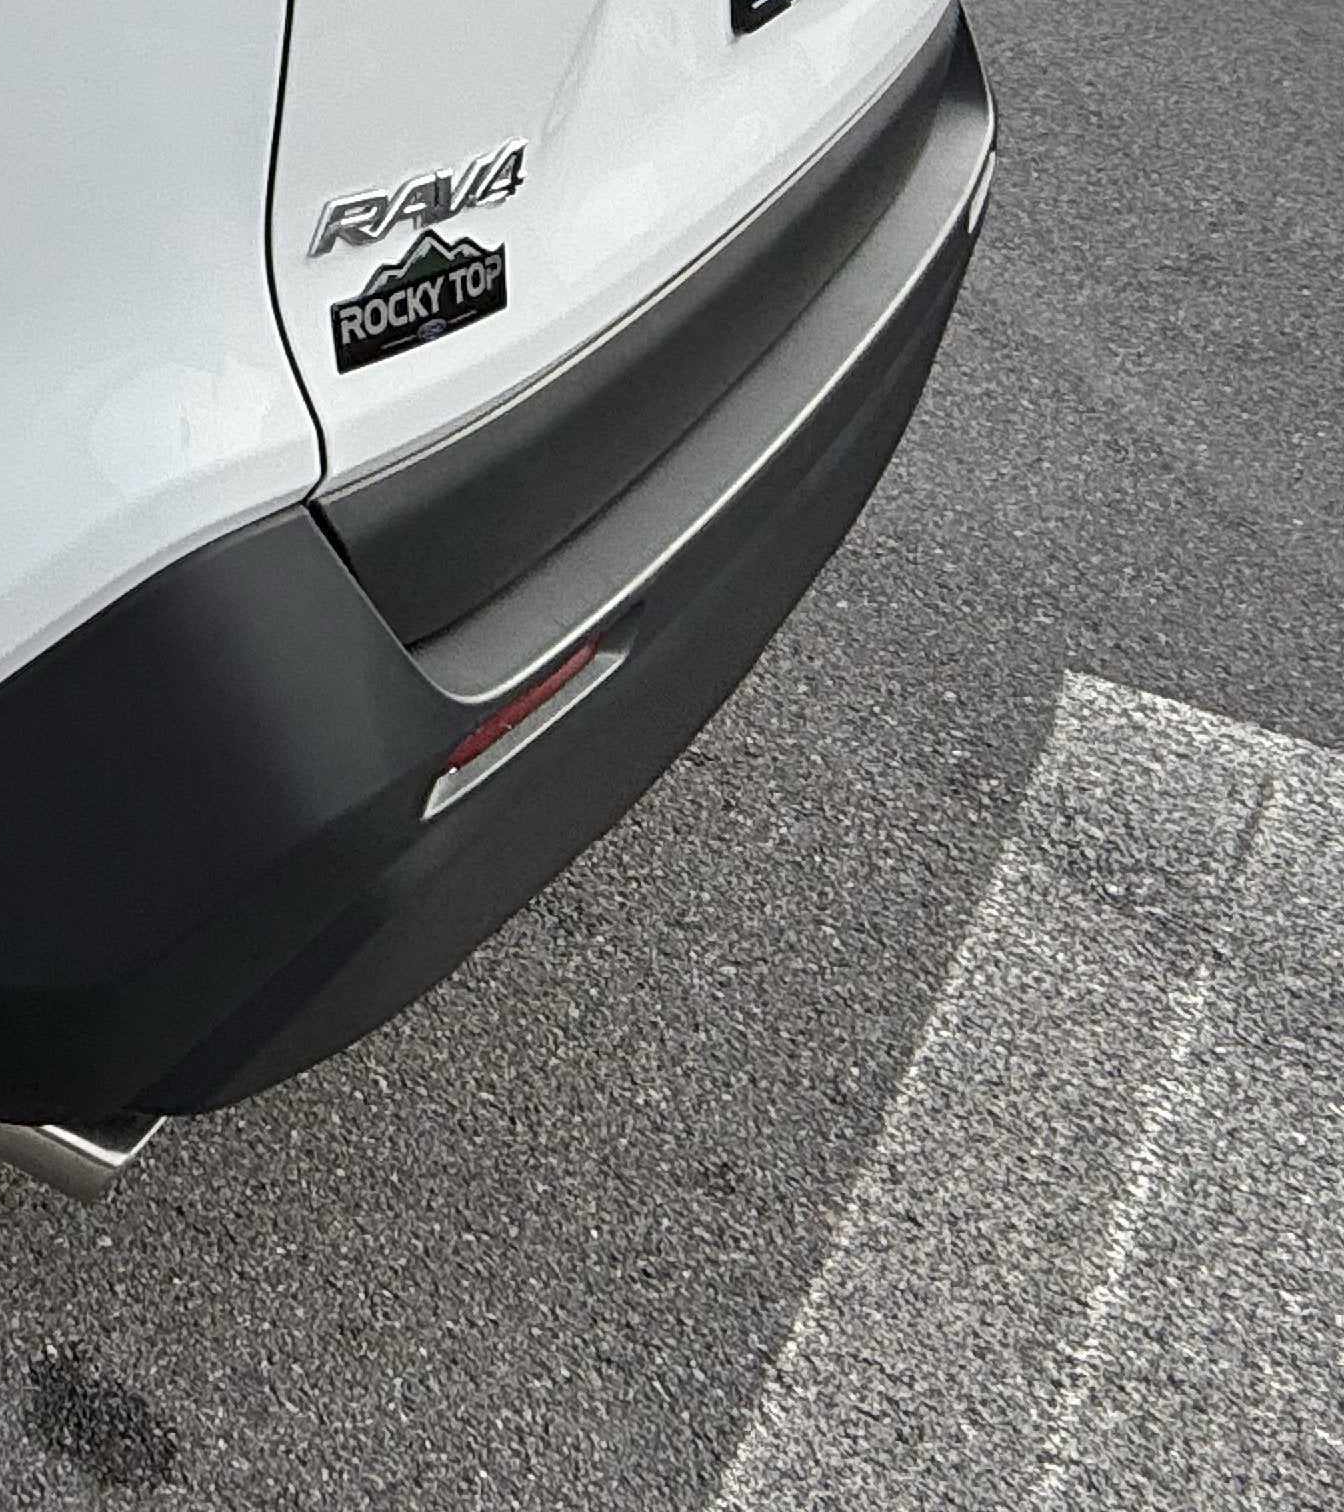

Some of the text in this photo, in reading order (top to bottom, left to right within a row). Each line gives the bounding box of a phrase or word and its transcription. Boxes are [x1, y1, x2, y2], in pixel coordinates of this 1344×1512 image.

[305, 136, 529, 259] RAV4
[339, 254, 502, 345] ROCKY TOP
